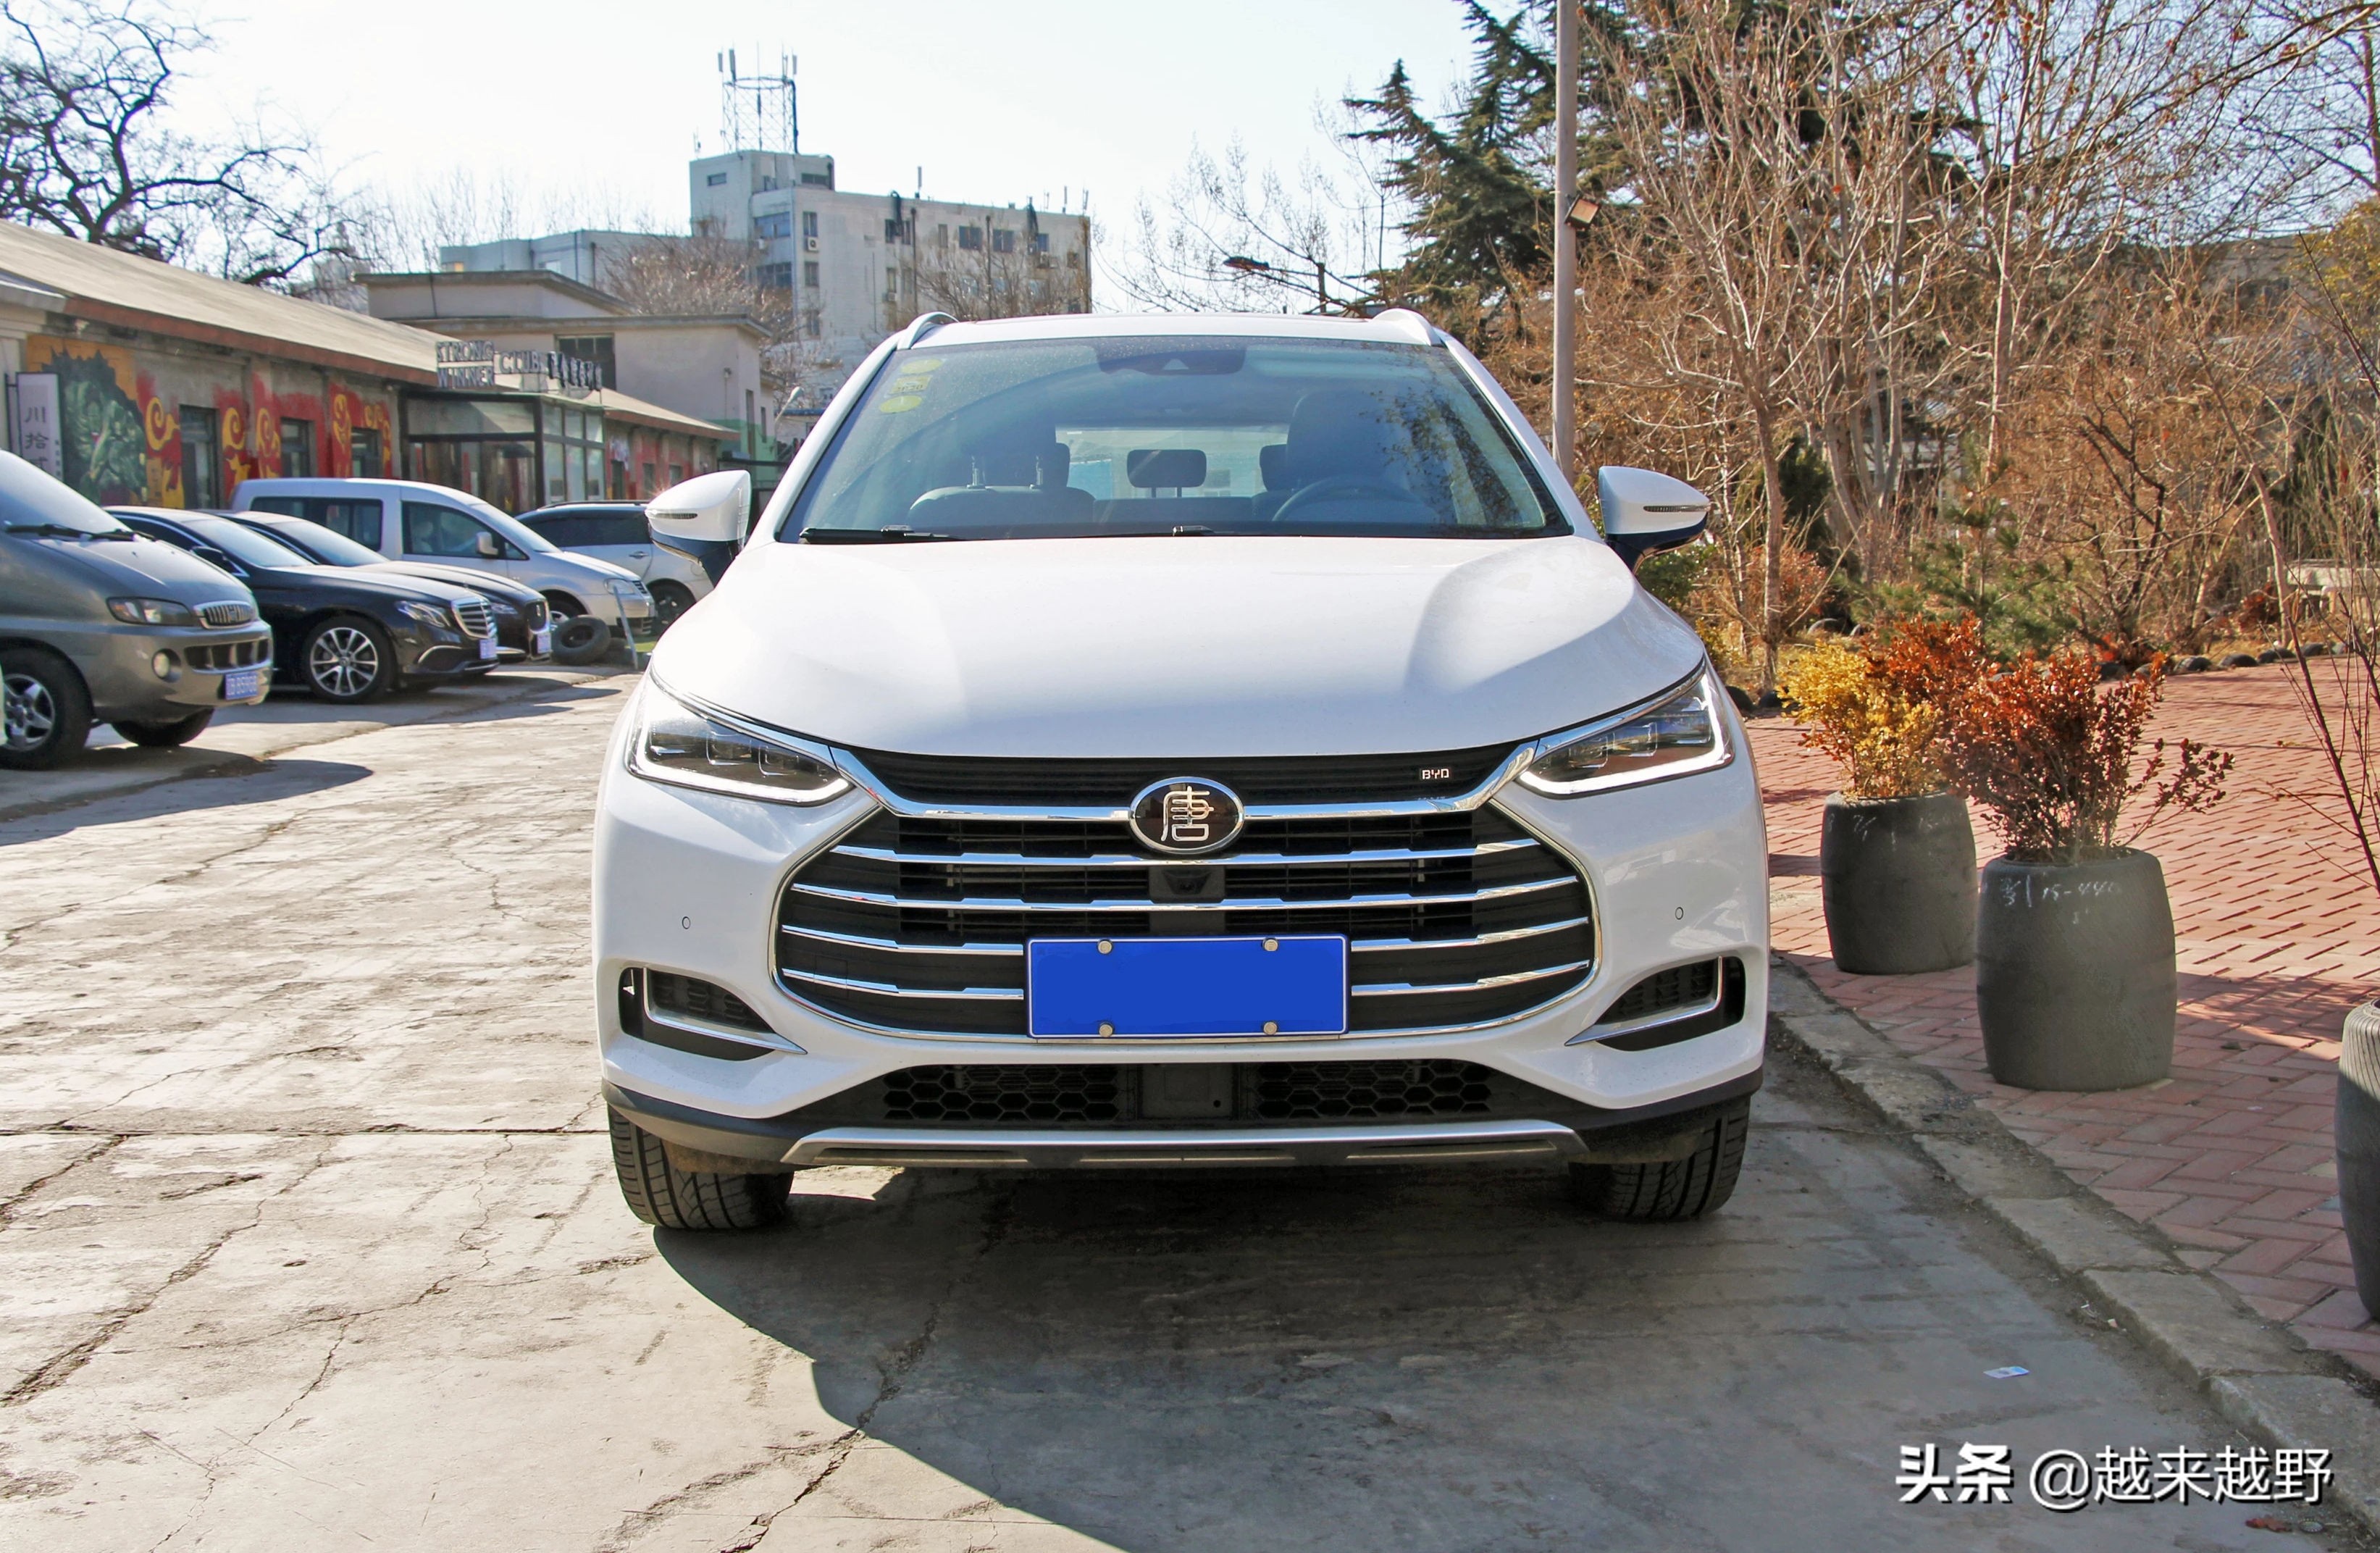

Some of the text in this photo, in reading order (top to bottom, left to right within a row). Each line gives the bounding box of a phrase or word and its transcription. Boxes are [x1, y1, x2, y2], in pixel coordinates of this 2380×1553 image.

[436, 341, 494, 361] STRONG
[500, 351, 542, 373] CLUB
[437, 367, 495, 388] WINNER
[1422, 768, 1449, 779] BYD
[1160, 786, 1215, 842] 唐
